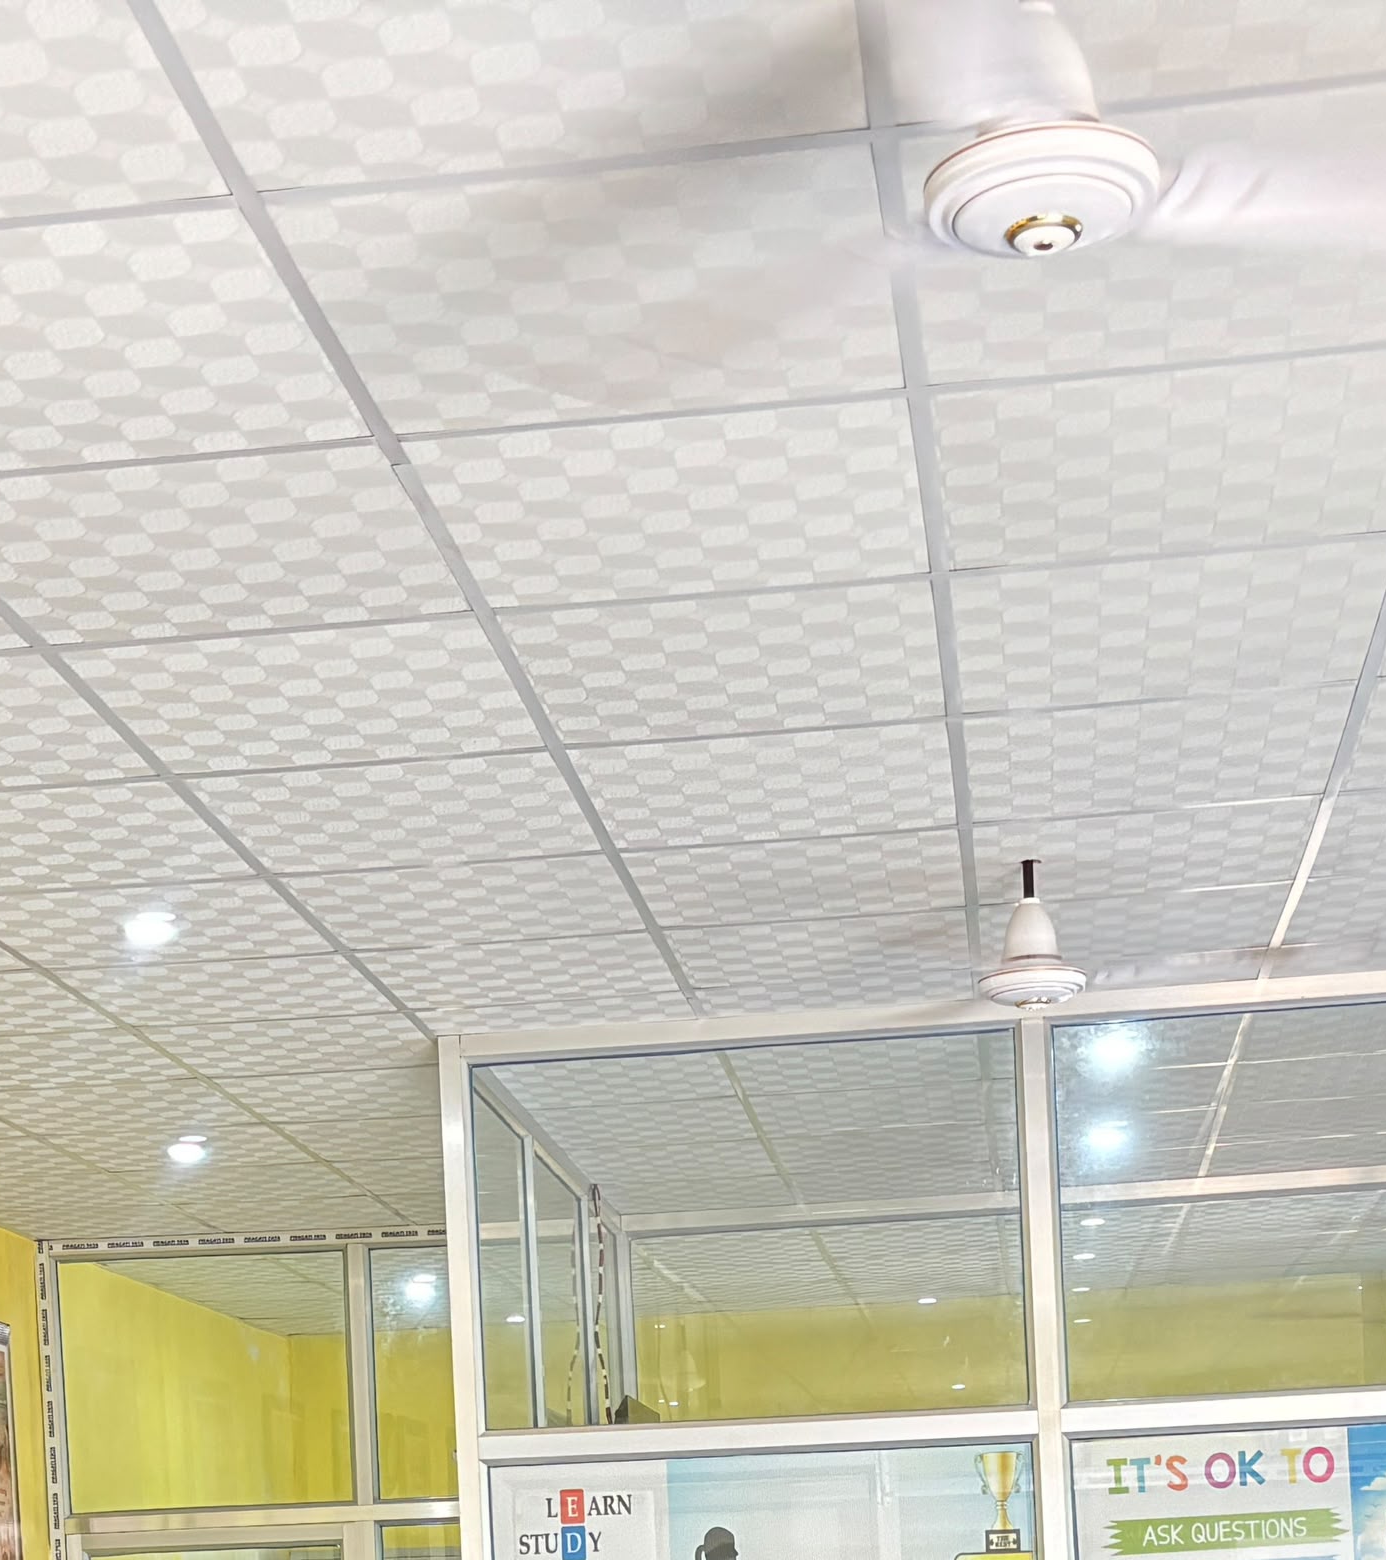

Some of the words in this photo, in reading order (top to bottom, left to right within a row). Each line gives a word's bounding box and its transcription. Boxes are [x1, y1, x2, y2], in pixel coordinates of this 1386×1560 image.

[1106, 1454, 1189, 1495] IT'S
[1204, 1450, 1266, 1489] OK
[1280, 1446, 1335, 1484] TO
[546, 1494, 632, 1519] LEARN
[519, 1531, 601, 1556] STUDY
[1143, 1524, 1184, 1547] ASK
[1191, 1516, 1307, 1544] QUESTIONS
